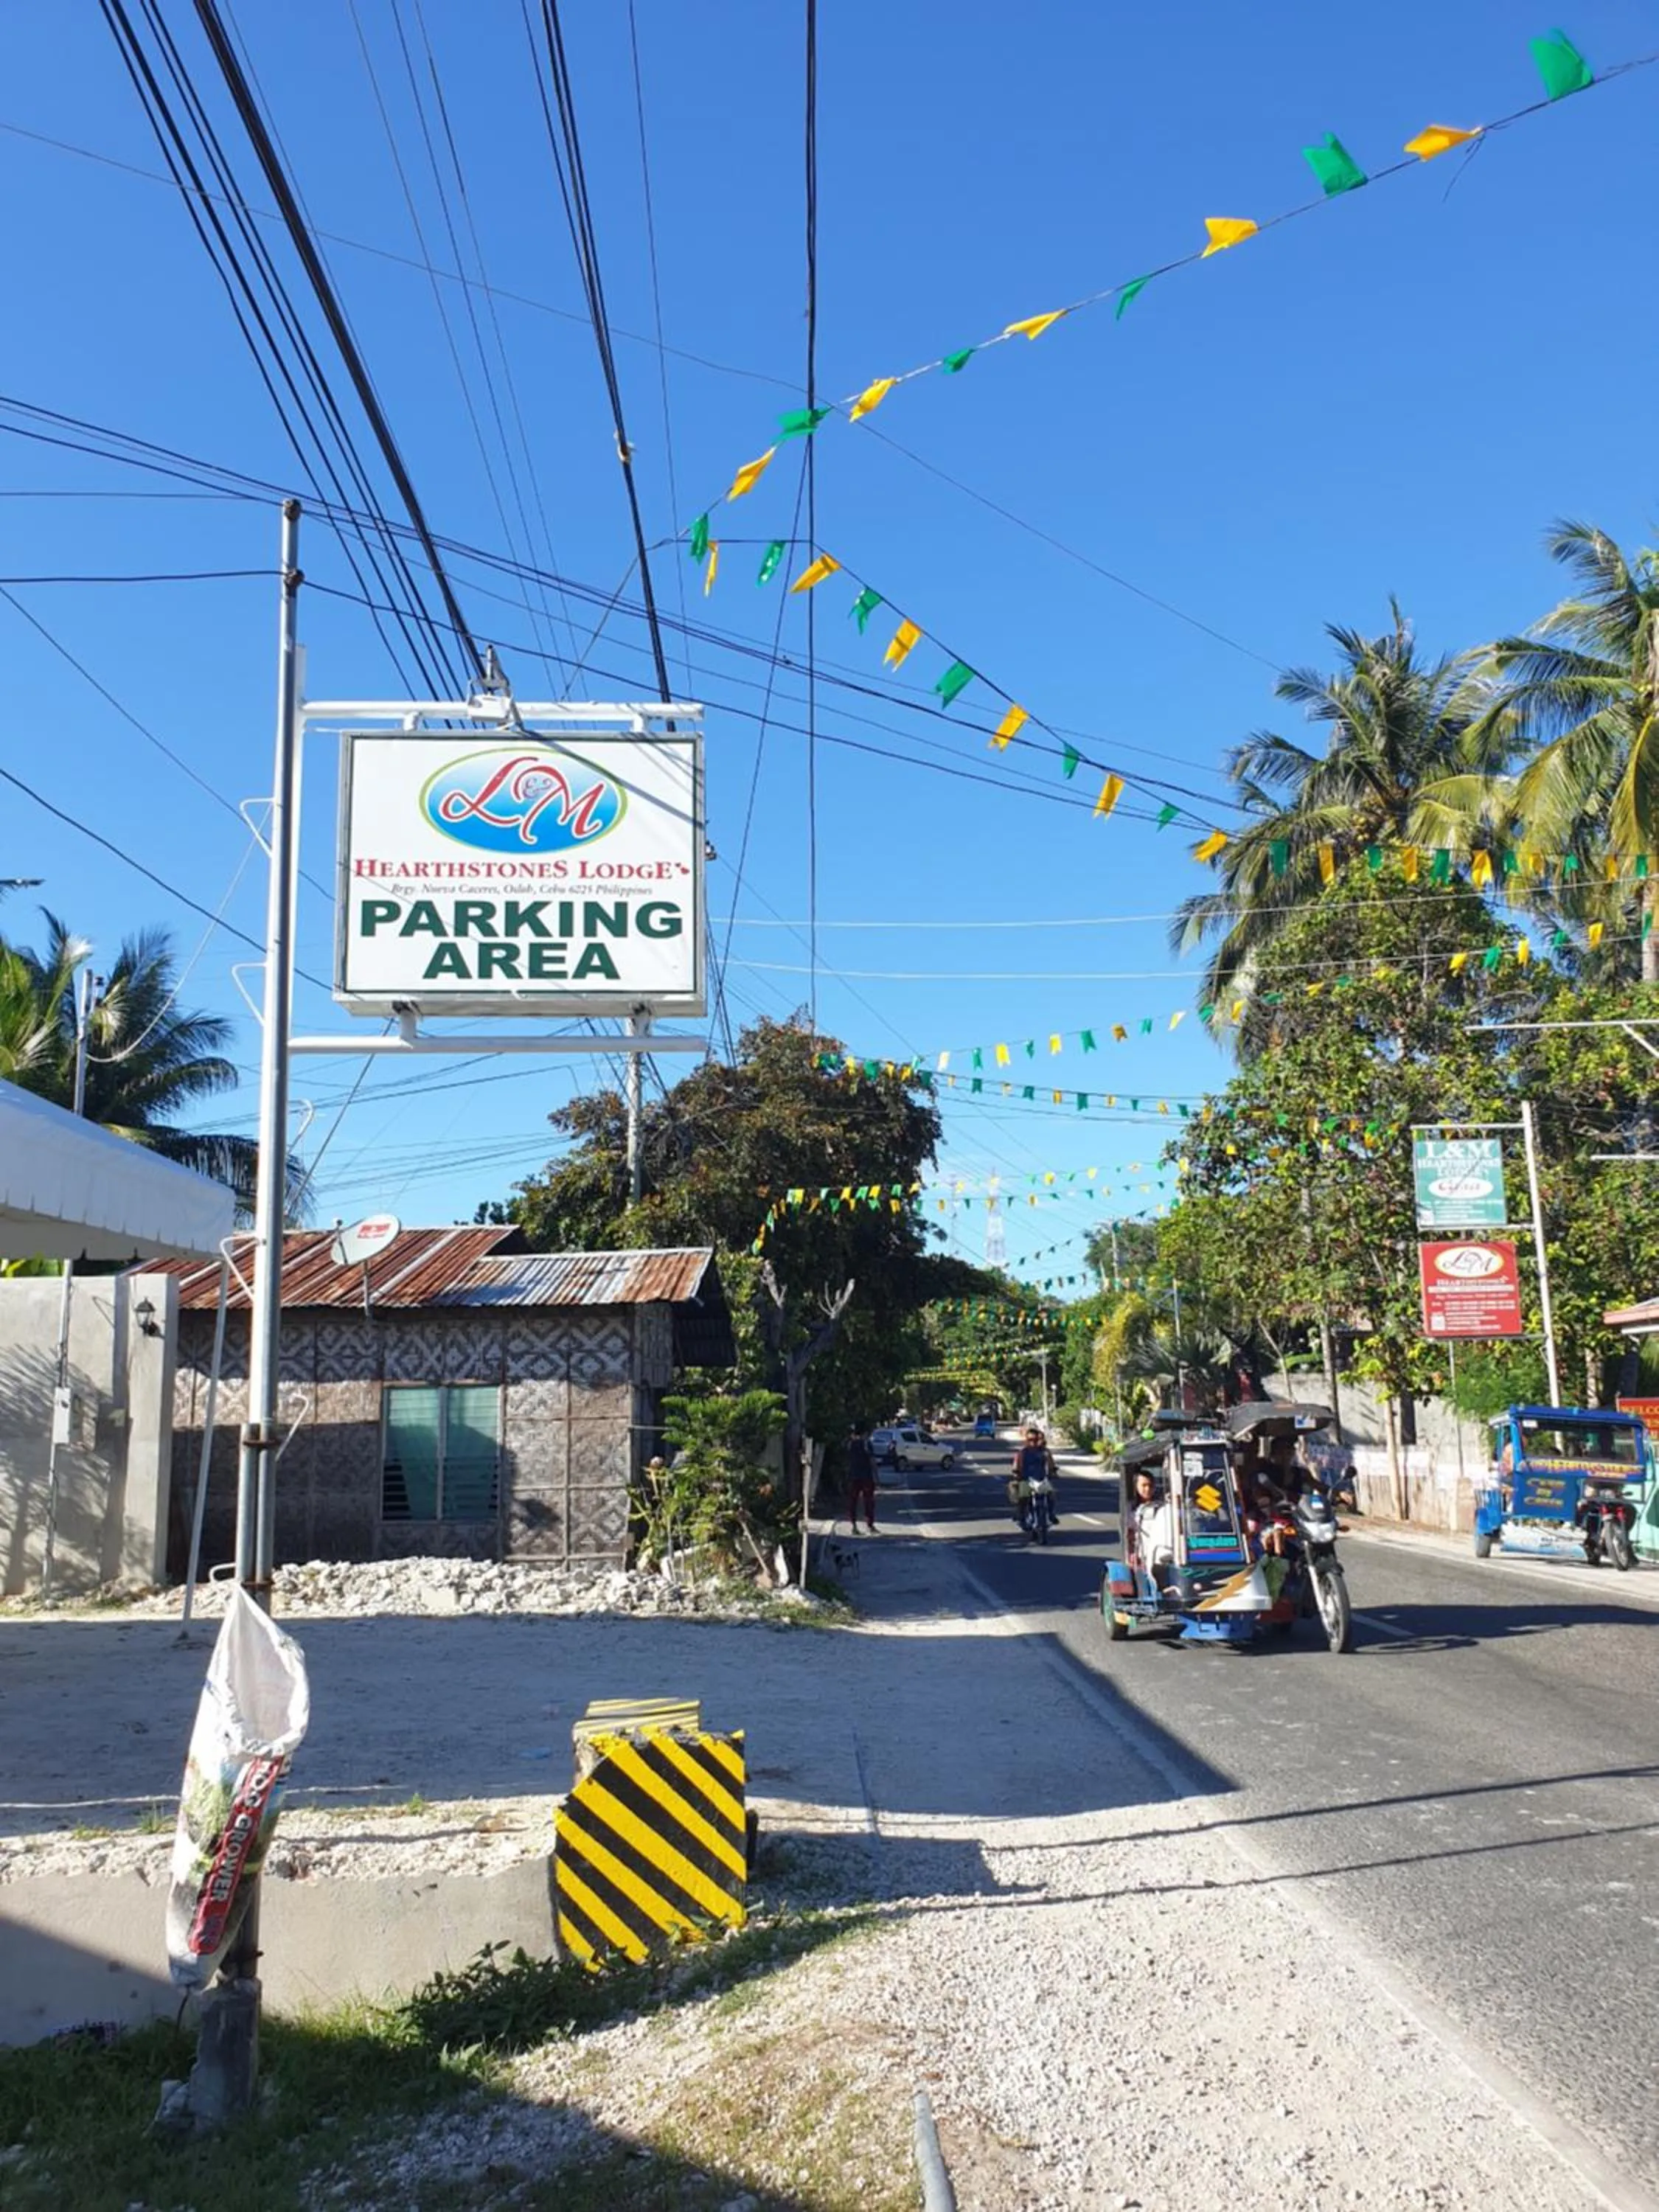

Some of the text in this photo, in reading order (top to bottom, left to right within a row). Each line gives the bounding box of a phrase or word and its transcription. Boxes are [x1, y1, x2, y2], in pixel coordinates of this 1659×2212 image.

[354, 858, 568, 879] HEARTHSTONES
[595, 885, 653, 897] Philippines
[361, 900, 683, 939] PARKING
[422, 942, 621, 980] AREA
[212, 1813, 251, 1902] GROWER
